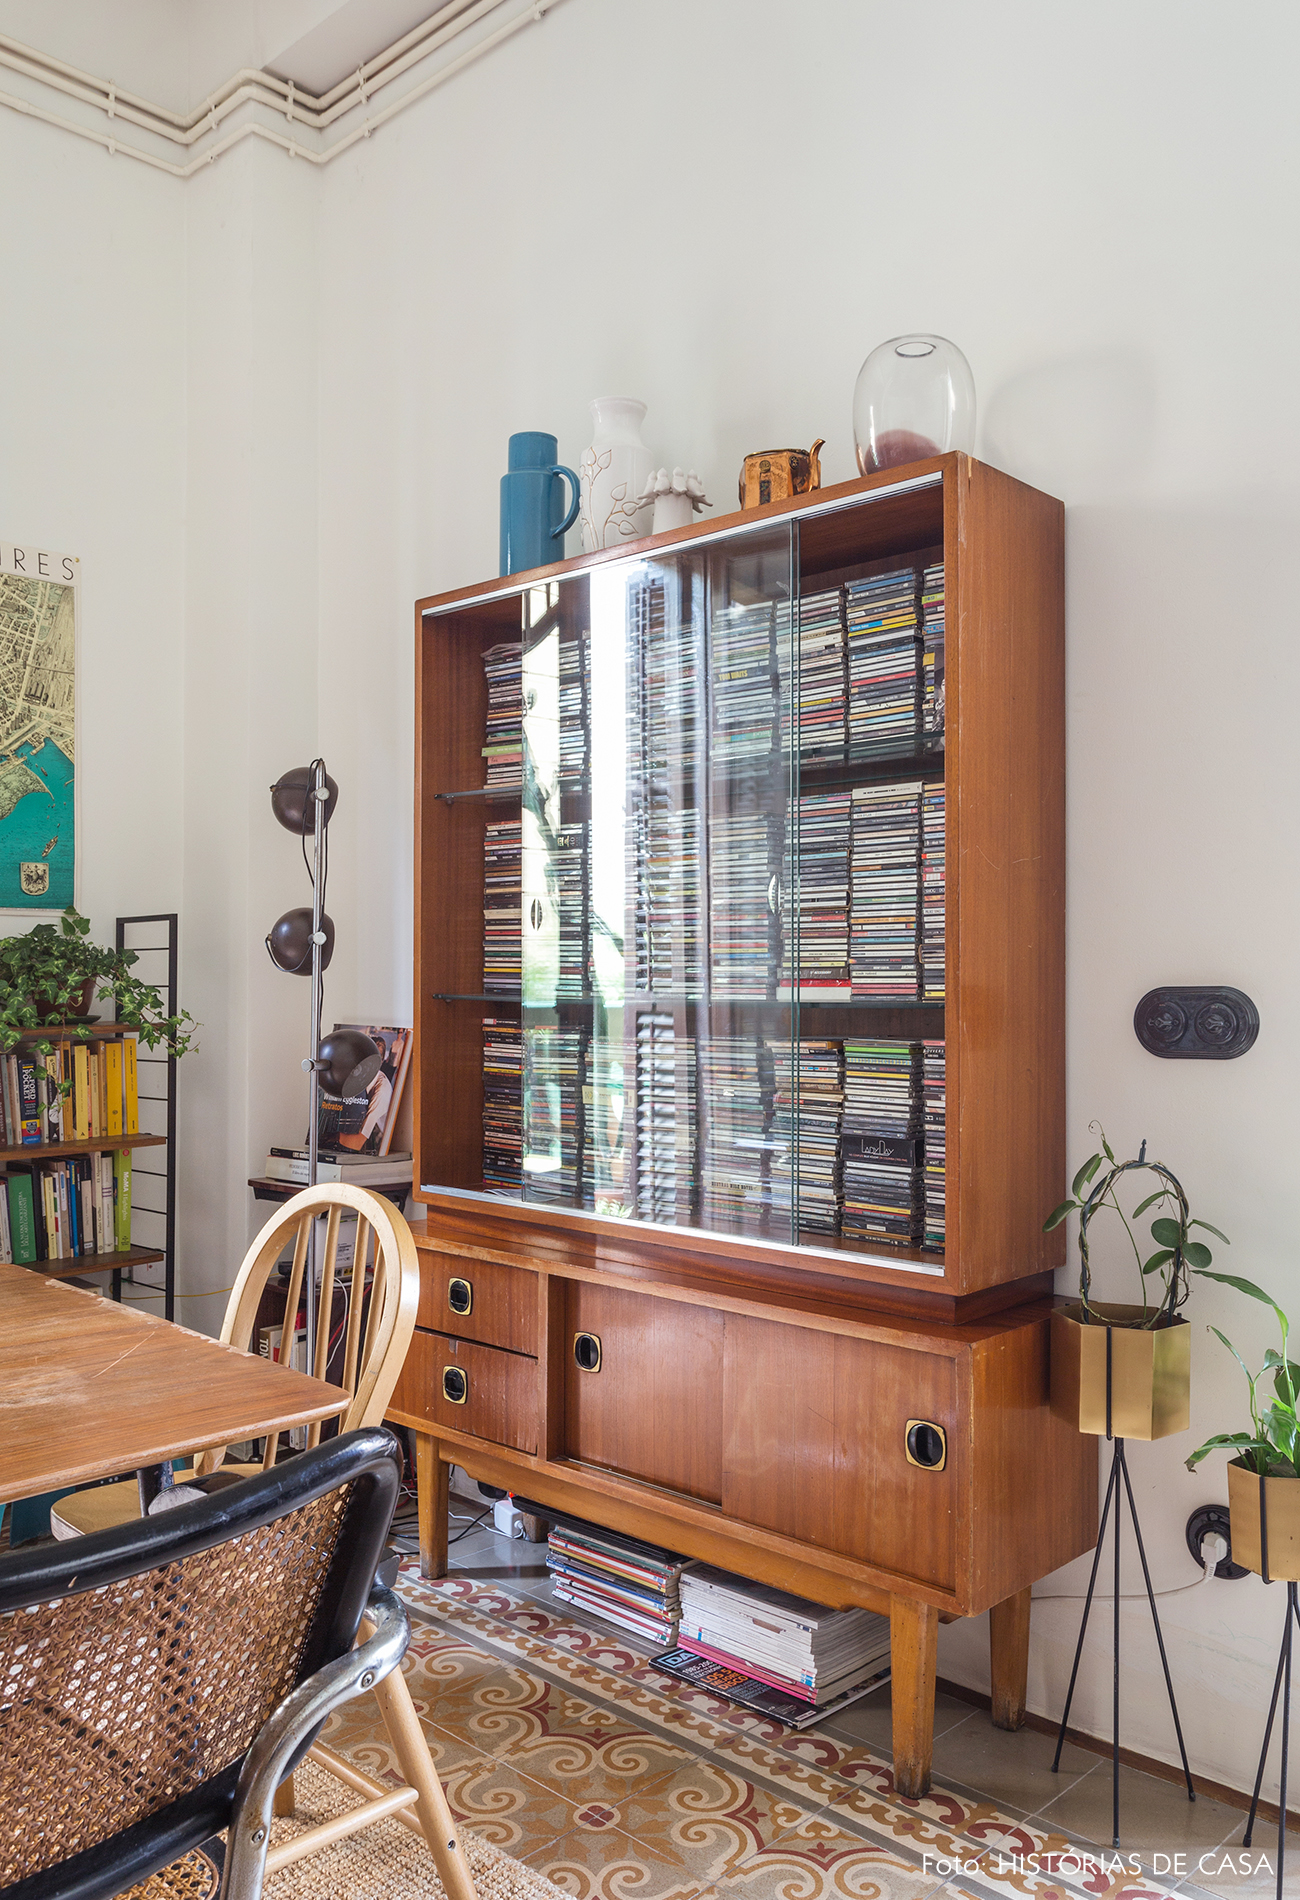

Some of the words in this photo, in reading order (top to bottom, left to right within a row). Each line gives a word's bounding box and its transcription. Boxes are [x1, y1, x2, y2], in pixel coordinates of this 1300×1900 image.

[22, 1069, 30, 1100] POCKET
[28, 1068, 36, 1100] OFORD
[321, 1101, 344, 1111] Retratos
[121, 1193, 129, 1221] Highlights
[665, 1652, 696, 1665] DA
[700, 1671, 724, 1683] LOS
[710, 1671, 741, 1687] MEJORE
[717, 1675, 749, 1690] DISCO
